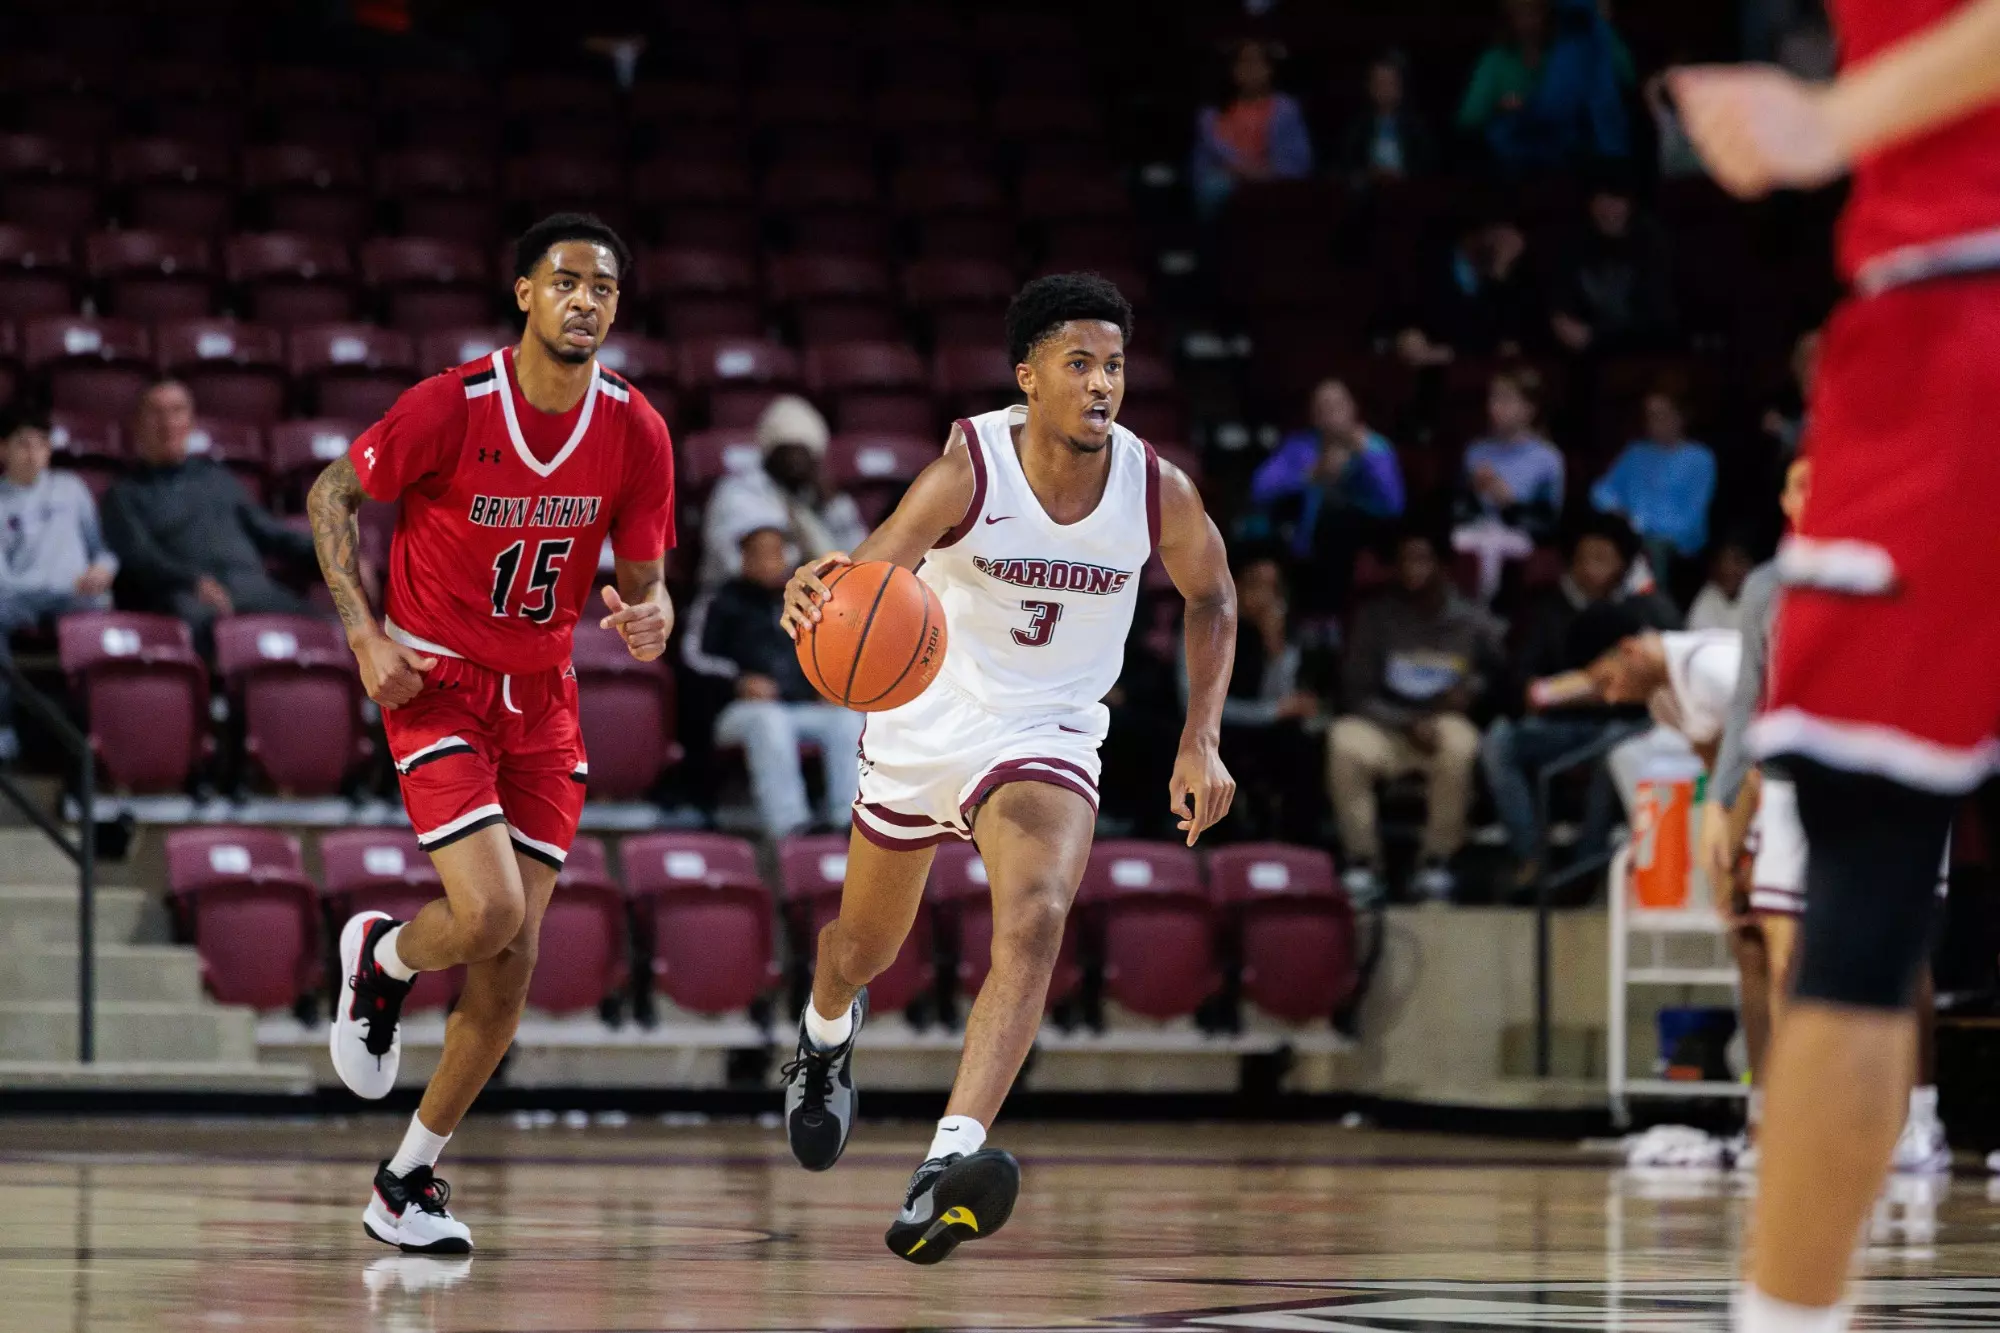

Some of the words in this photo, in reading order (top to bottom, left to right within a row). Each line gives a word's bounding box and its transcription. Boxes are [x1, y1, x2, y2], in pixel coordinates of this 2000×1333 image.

[468, 495, 531, 528] BRYN
[528, 496, 602, 528] ATHYN
[491, 537, 575, 624] 15
[973, 555, 1133, 595] MAROONS
[1010, 600, 1064, 647] 3
